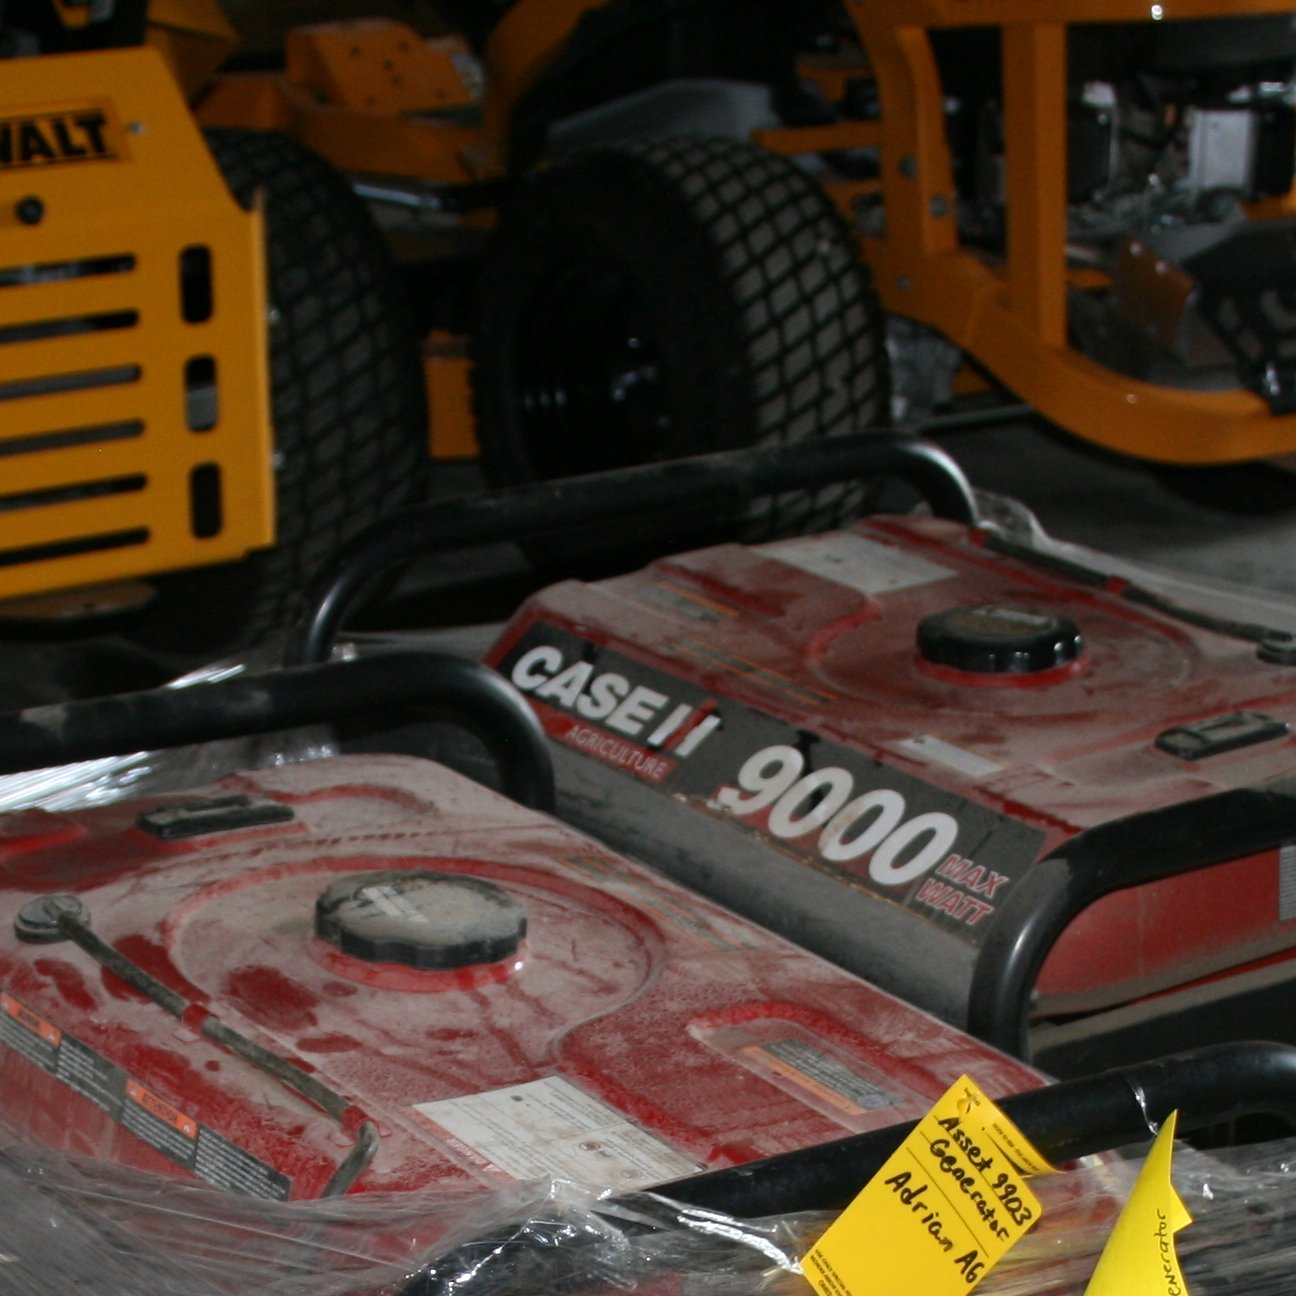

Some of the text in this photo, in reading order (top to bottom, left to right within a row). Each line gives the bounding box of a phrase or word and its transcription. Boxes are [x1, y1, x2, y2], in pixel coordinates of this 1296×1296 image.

[512, 645, 670, 736] CASE
[564, 724, 668, 778] AGRICULTURE
[717, 744, 959, 886] 9000
[916, 878, 994, 925] WATT
[935, 853, 1009, 898] MAX
[938, 1116, 994, 1172] Asset
[884, 1170, 953, 1252] Adrian
